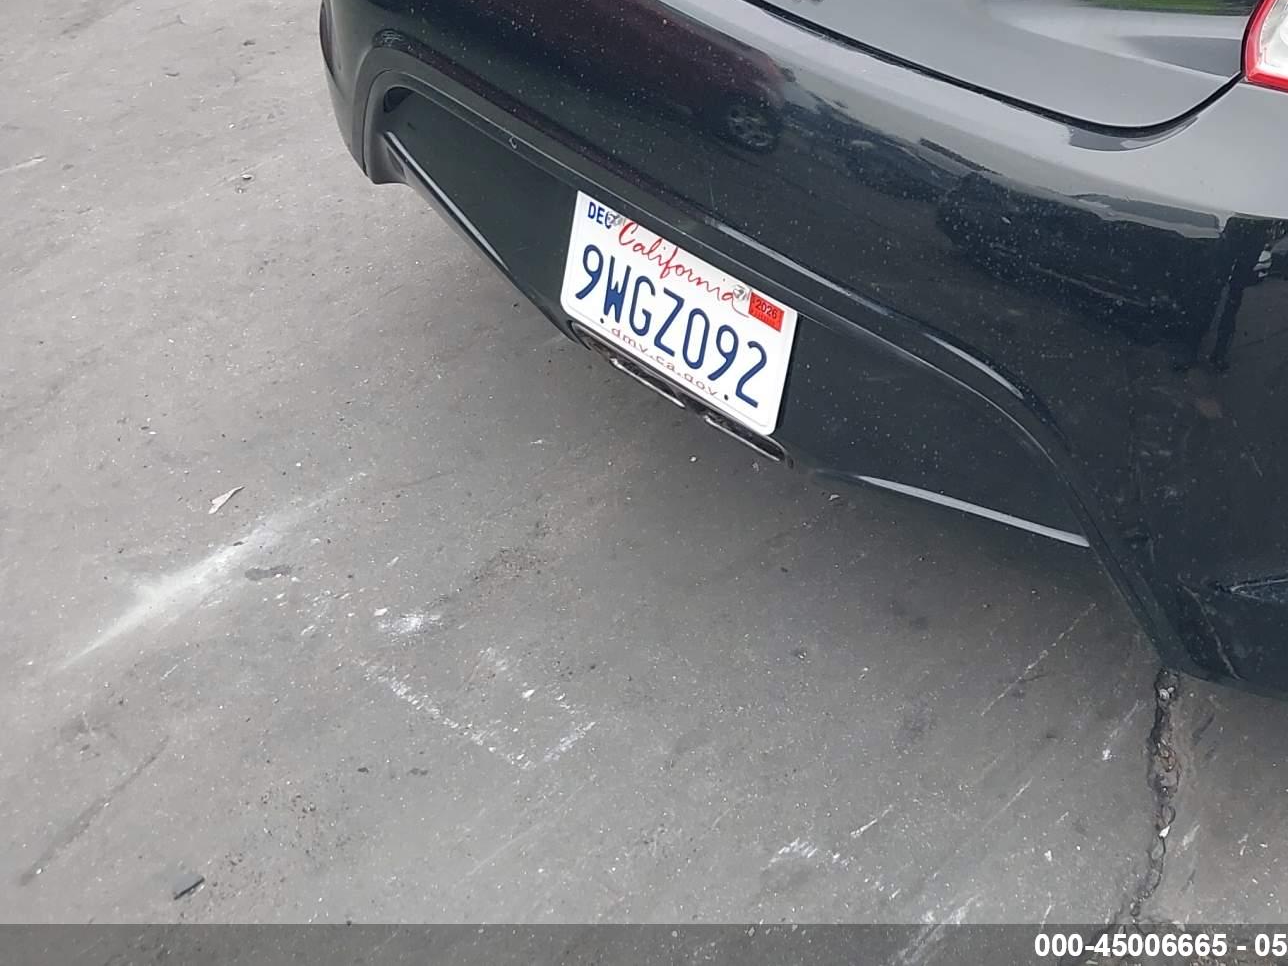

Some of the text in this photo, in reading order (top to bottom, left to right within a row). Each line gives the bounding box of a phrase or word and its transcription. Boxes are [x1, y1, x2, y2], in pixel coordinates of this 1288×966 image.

[618, 221, 749, 318] California
[755, 298, 778, 320] 2026
[575, 244, 768, 408] 9WGZ092
